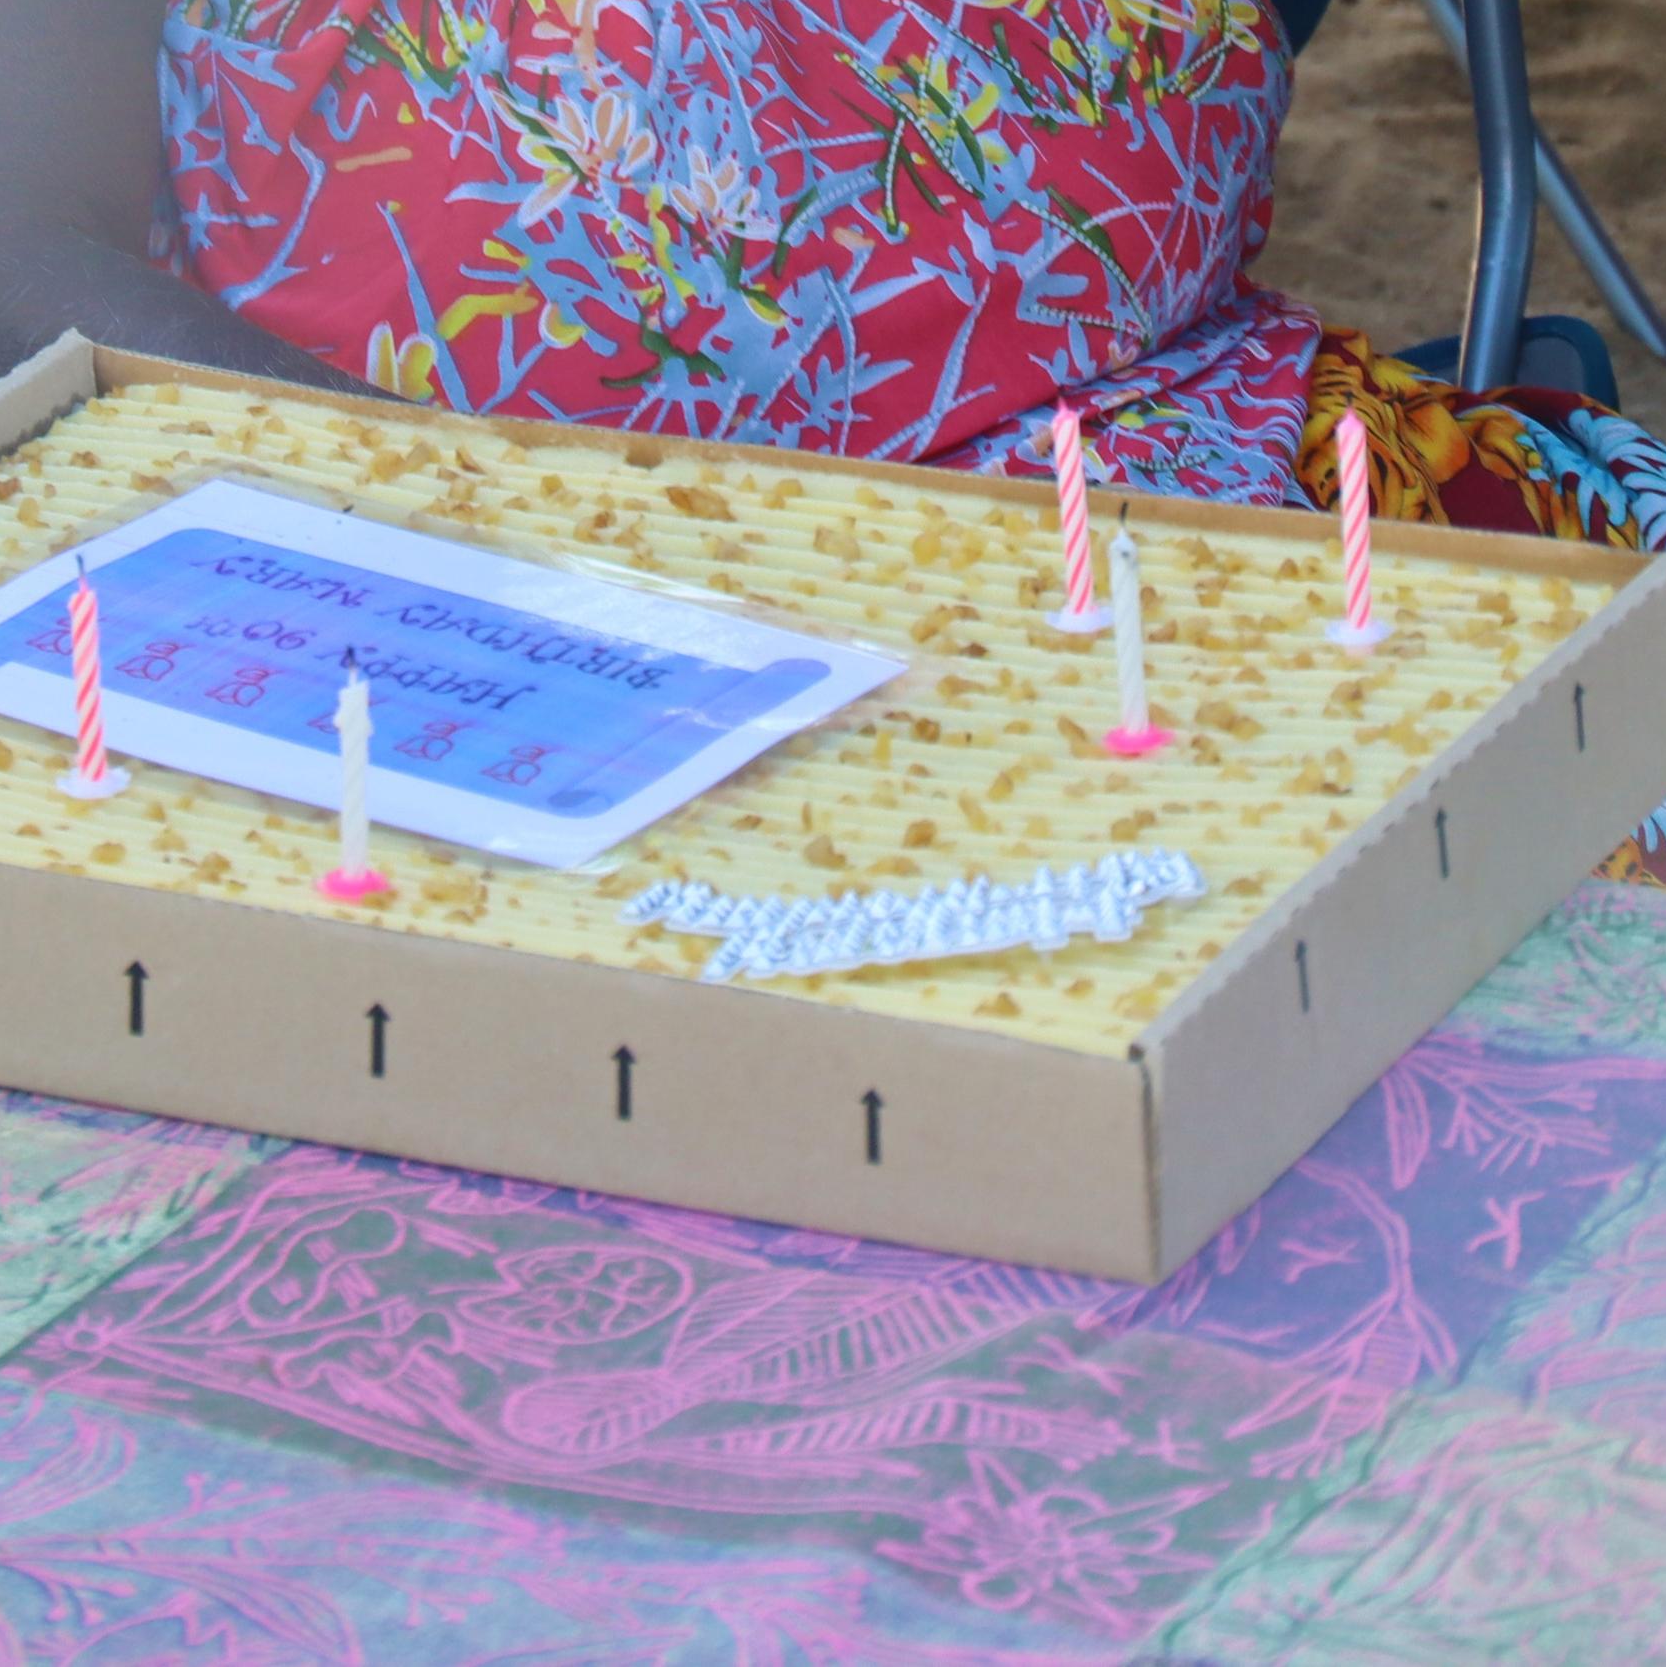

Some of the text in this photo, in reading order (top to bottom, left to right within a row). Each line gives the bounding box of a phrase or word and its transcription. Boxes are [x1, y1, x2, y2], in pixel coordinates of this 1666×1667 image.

[189, 556, 671, 690] BIRTHDAY MARY
[314, 644, 537, 710] HAPPY
